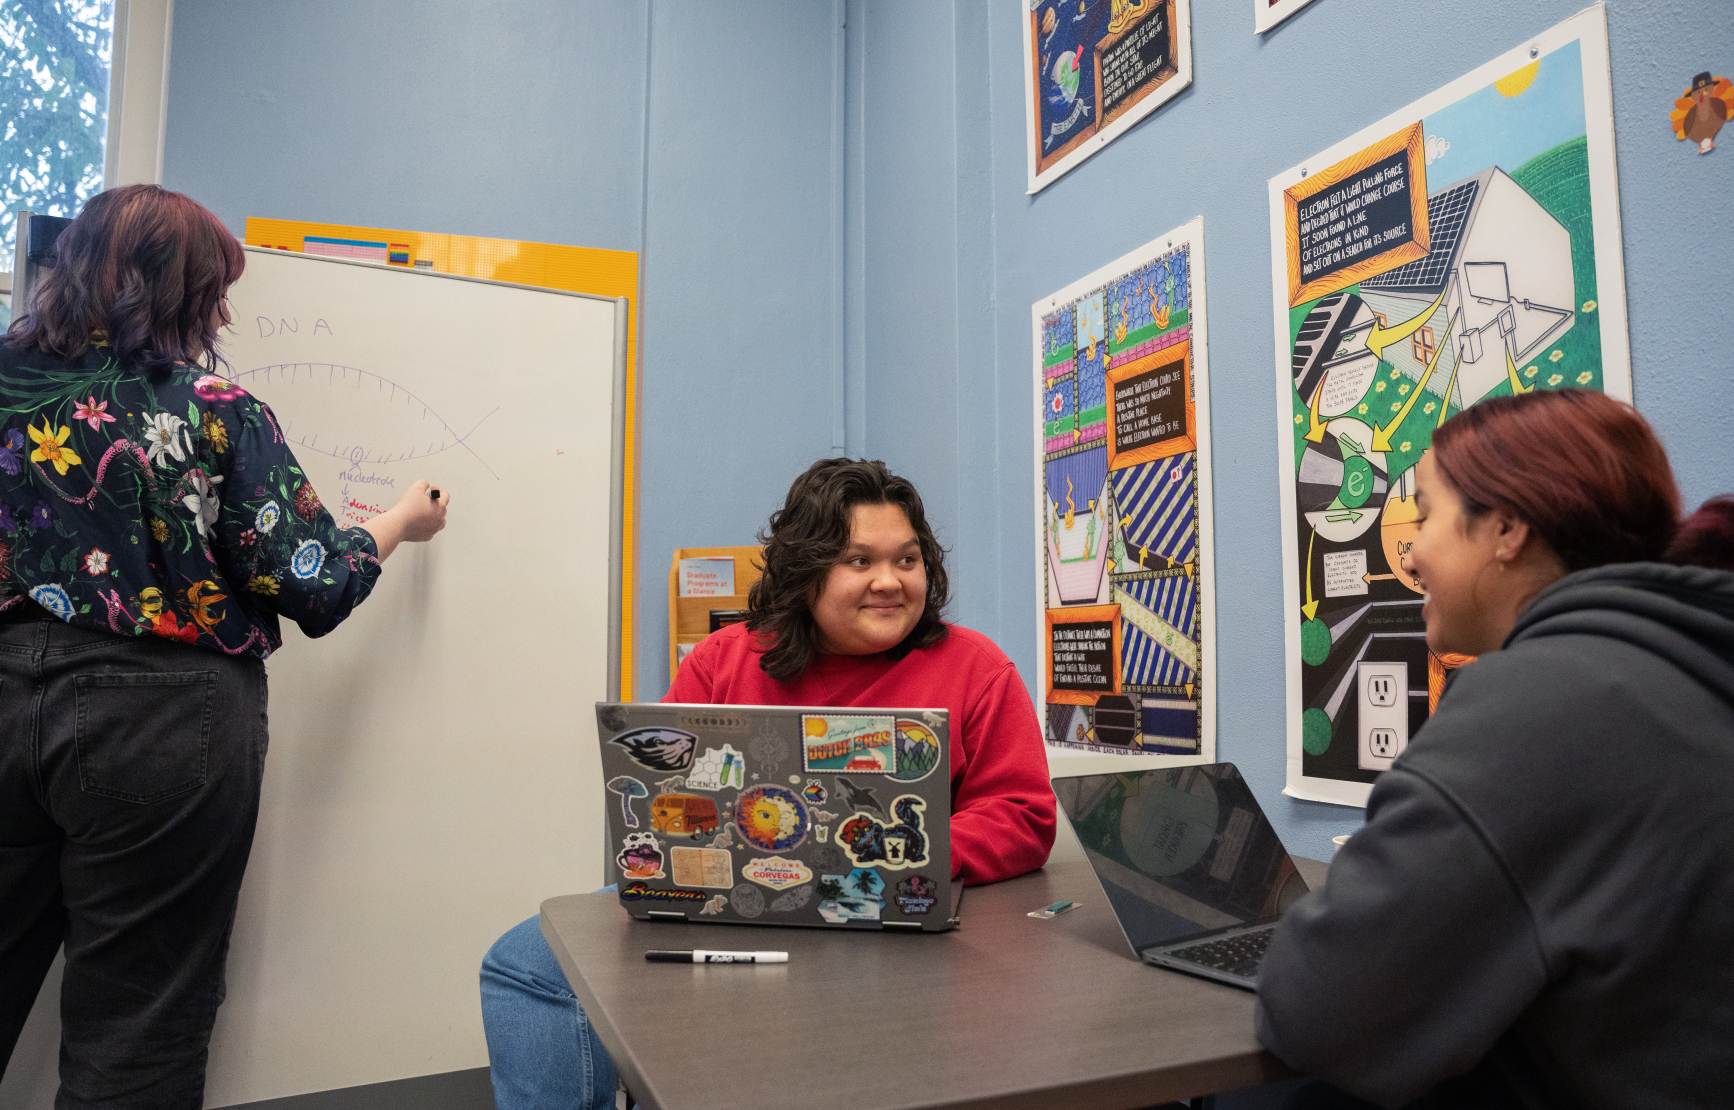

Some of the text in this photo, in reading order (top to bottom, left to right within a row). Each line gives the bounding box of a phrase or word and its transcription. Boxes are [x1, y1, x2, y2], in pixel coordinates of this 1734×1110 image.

[1145, 13, 1159, 32] LIGHT
[1120, 60, 1129, 74] OUR
[1129, 51, 1140, 66] STAR
[1135, 67, 1146, 83] GREAT
[1146, 54, 1162, 74] FLIGHT
[1104, 77, 1122, 98] DESTINED
[1127, 66, 1134, 78] GO
[1301, 198, 1329, 220] ELECTRON
[1330, 192, 1340, 207] FELT
[1342, 189, 1346, 201] A
[1384, 163, 1403, 180] FORCE
[1301, 222, 1311, 235] AND
[1329, 208, 1339, 222] THAT
[1345, 199, 1360, 214] WOULD
[1361, 187, 1382, 206] CHANGE
[1383, 177, 1405, 197] COURSE
[1302, 237, 1309, 249] IT
[1312, 228, 1329, 244] SOON
[1330, 220, 1346, 236] FOUND
[1348, 218, 1352, 228] A
[1303, 249, 1312, 261] OF
[1313, 236, 1342, 258] ELECTRONS
[1303, 263, 1313, 275] AND
[1314, 258, 1322, 270] SET
[1322, 254, 1332, 267] OUT
[1333, 249, 1340, 263] ON
[1342, 250, 1346, 260] A
[1346, 241, 1363, 257] SEARCH
[1364, 237, 1372, 249] FOR
[1384, 223, 1406, 241] SOURCE
[256, 316, 333, 338] DNA
[1142, 377, 1158, 391] ELECTRON
[1160, 374, 1171, 385] COULD
[1172, 370, 1180, 381] SEE
[1126, 399, 1134, 408] WAS
[1140, 394, 1150, 404] MUCH
[1117, 414, 1120, 424] A
[1136, 406, 1148, 416] PLACE
[1117, 414, 1162, 434] TO CALL A HOME BASE
[1122, 433, 1133, 444] WHERE
[1134, 428, 1150, 442] ELECTRON
[1151, 425, 1165, 436] WANTED
[1166, 423, 1172, 432] TO
[1173, 421, 1179, 430] BE
[1054, 664, 1065, 672] WOULD
[1054, 674, 1059, 682] OF
[1093, 676, 1106, 684] OCEAN
[808, 731, 891, 760] DUTCH BROS
[1064, 742, 1084, 750] HAPPENING
[687, 780, 718, 789] SCIENCE
[753, 871, 800, 879] CORVEGAS
[621, 882, 707, 903] Beavers
